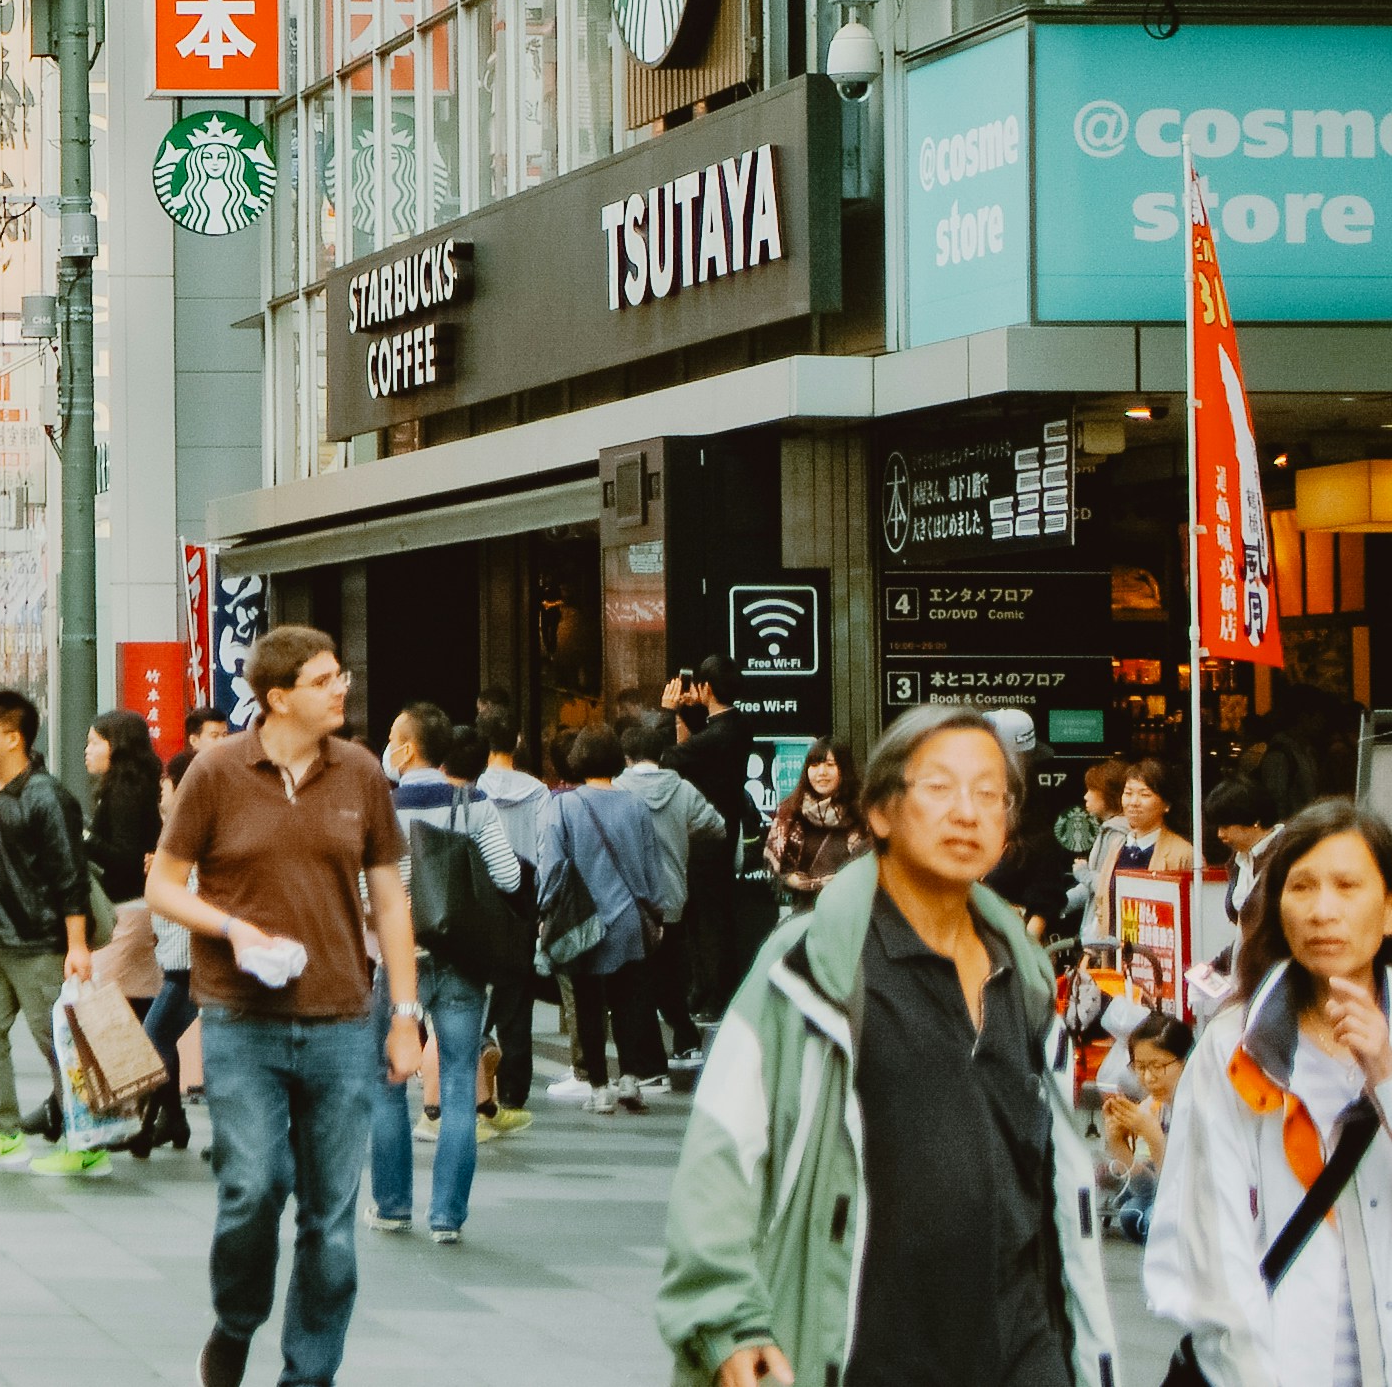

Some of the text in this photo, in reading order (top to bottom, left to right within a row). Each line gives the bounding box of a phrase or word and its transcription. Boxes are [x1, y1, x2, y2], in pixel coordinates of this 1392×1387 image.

[1072, 98, 1392, 159] @cosm
[919, 114, 1020, 192] @cosme
[1132, 174, 1376, 245] store
[600, 142, 784, 312] TSUTAYA
[935, 198, 1005, 268] store
[71, 234, 91, 245] CH1
[347, 237, 458, 335] STARBUCKS
[366, 323, 438, 401] COFFEE
[886, 464, 908, 539] 本
[894, 593, 911, 615] 4
[929, 588, 1034, 602] エンタメフロア
[928, 609, 1025, 620] CD/DVD Comic
[747, 658, 772, 668] Free
[896, 677, 912, 699] 3
[929, 671, 1066, 687] 本とコスメのフロア
[929, 693, 961, 704] Book
[975, 693, 1037, 705] Cosmetics
[1038, 773, 1067, 787] ロア
